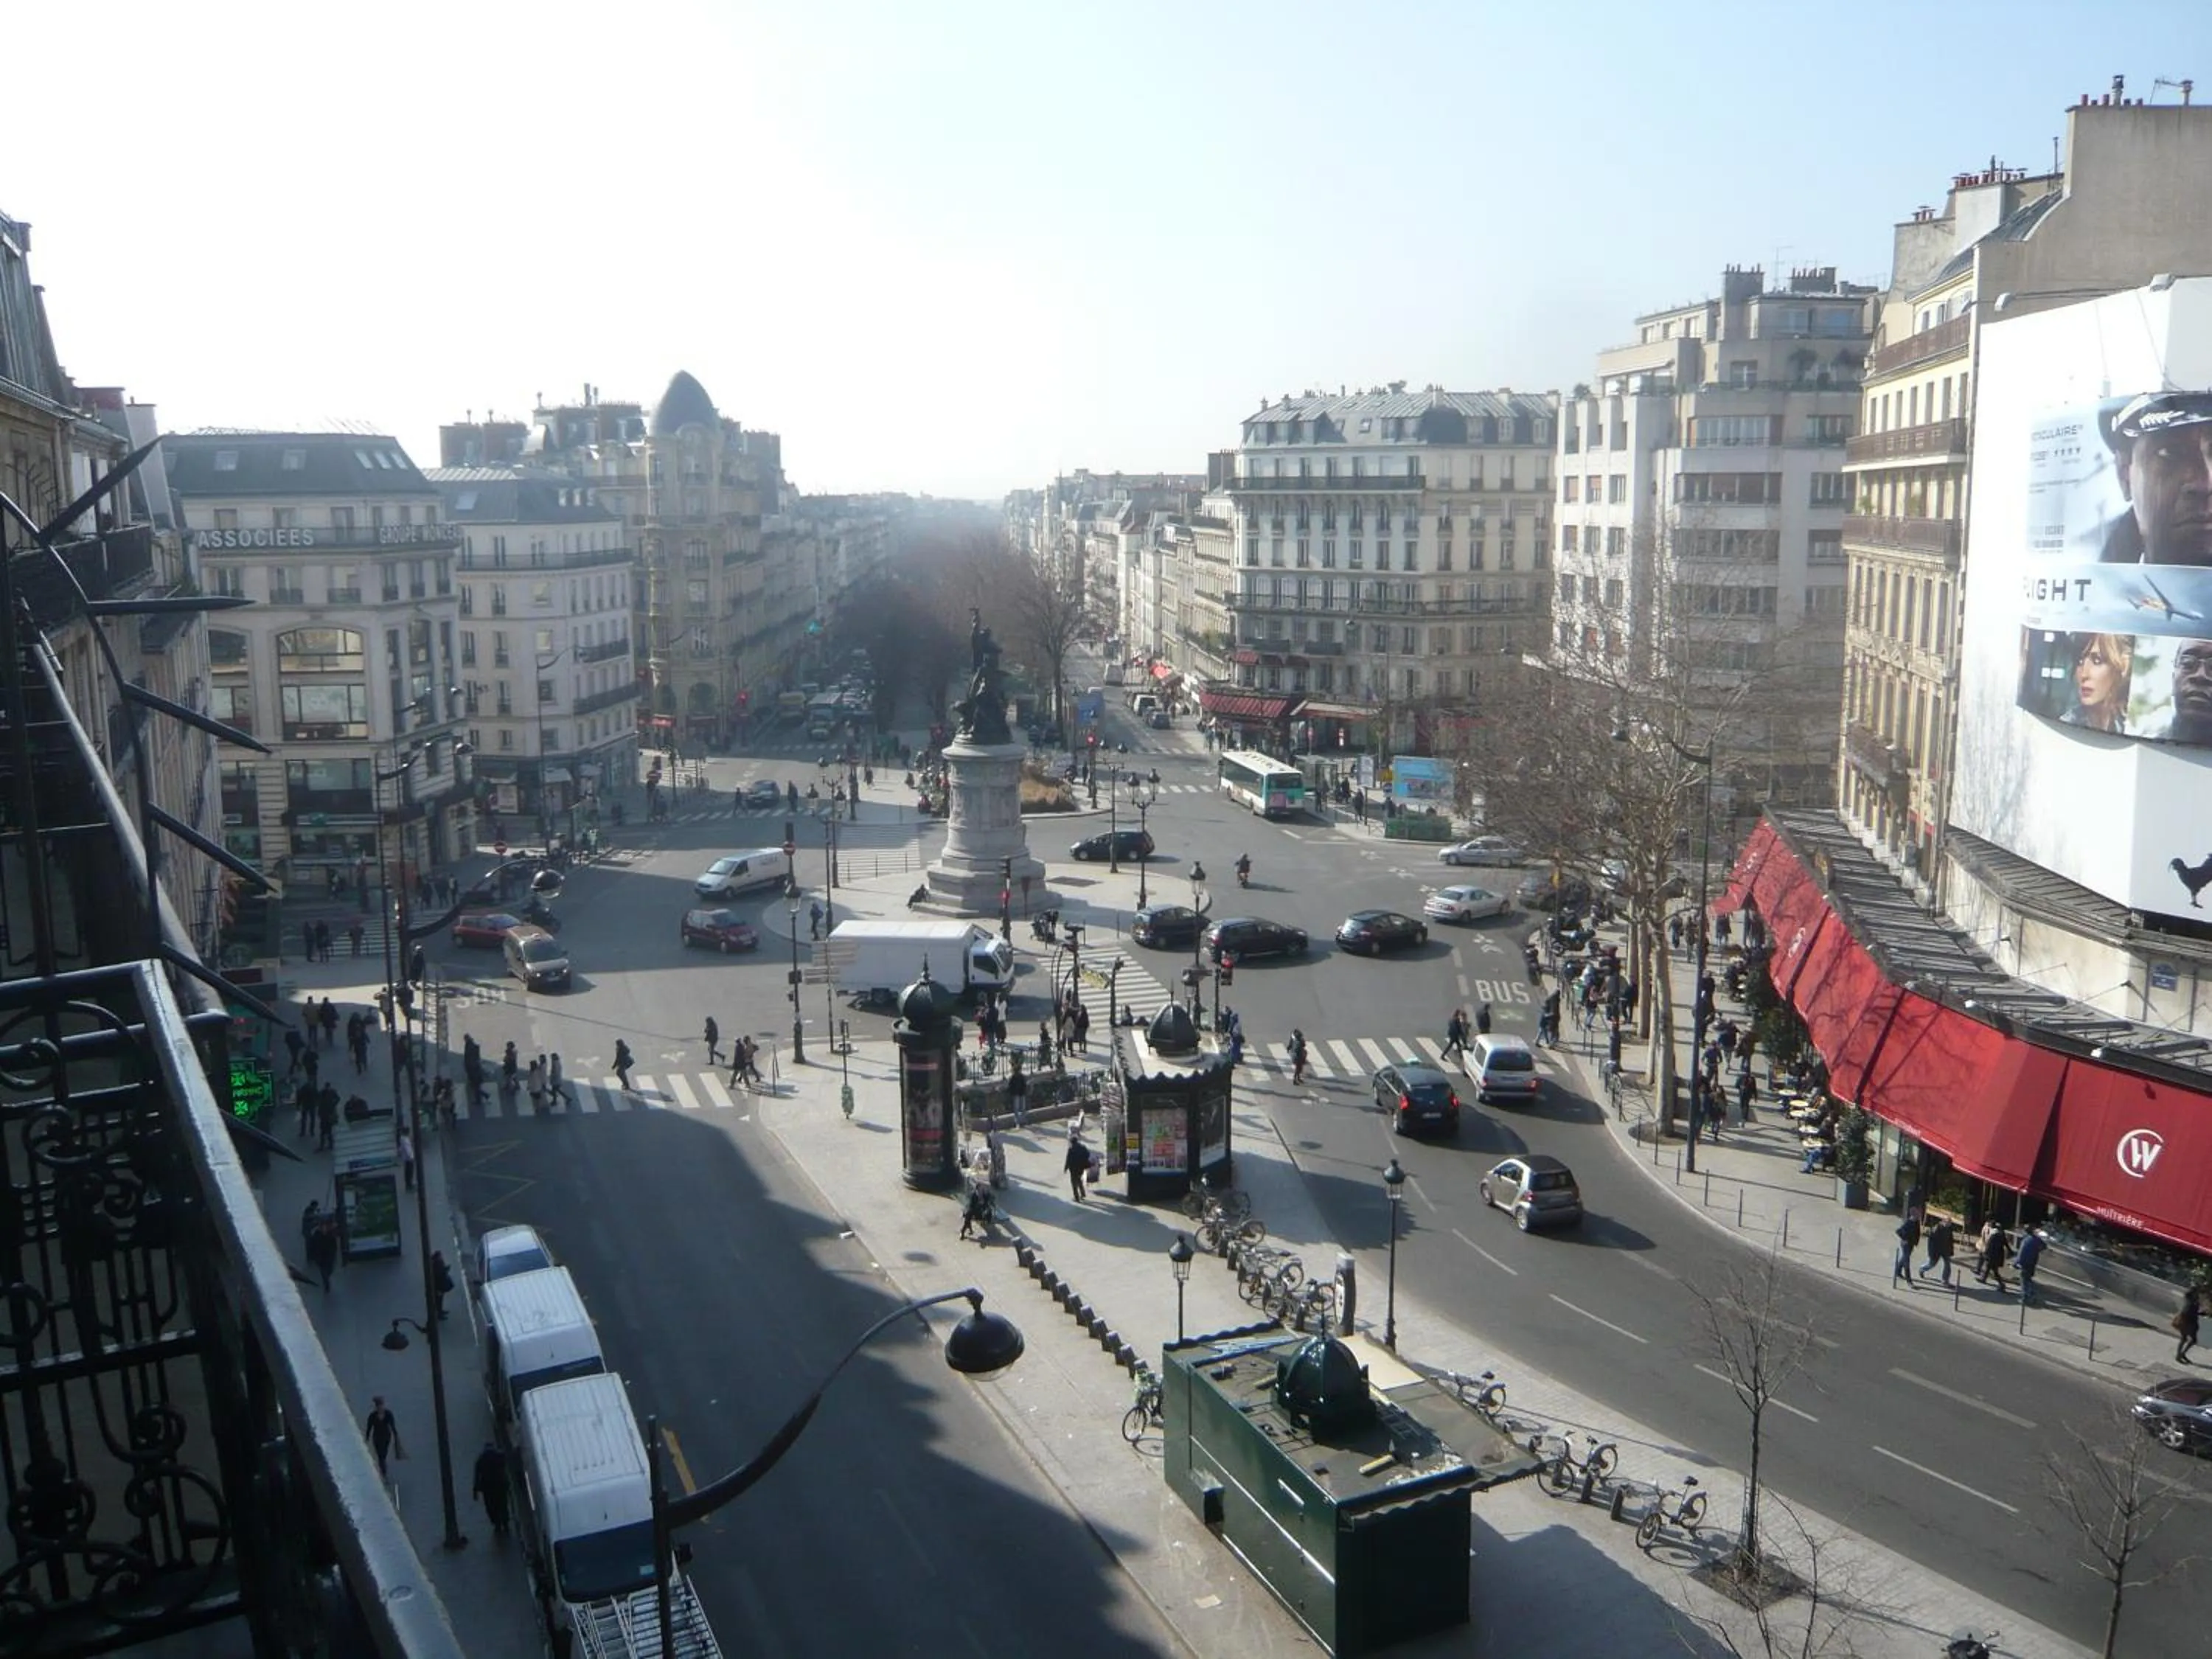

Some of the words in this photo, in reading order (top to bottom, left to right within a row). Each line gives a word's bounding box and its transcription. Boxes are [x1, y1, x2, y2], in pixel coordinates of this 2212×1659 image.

[198, 529, 315, 548] ASSOCIEES
[2023, 577, 2093, 602] IGHT
[1475, 979, 1531, 1004] BUS
